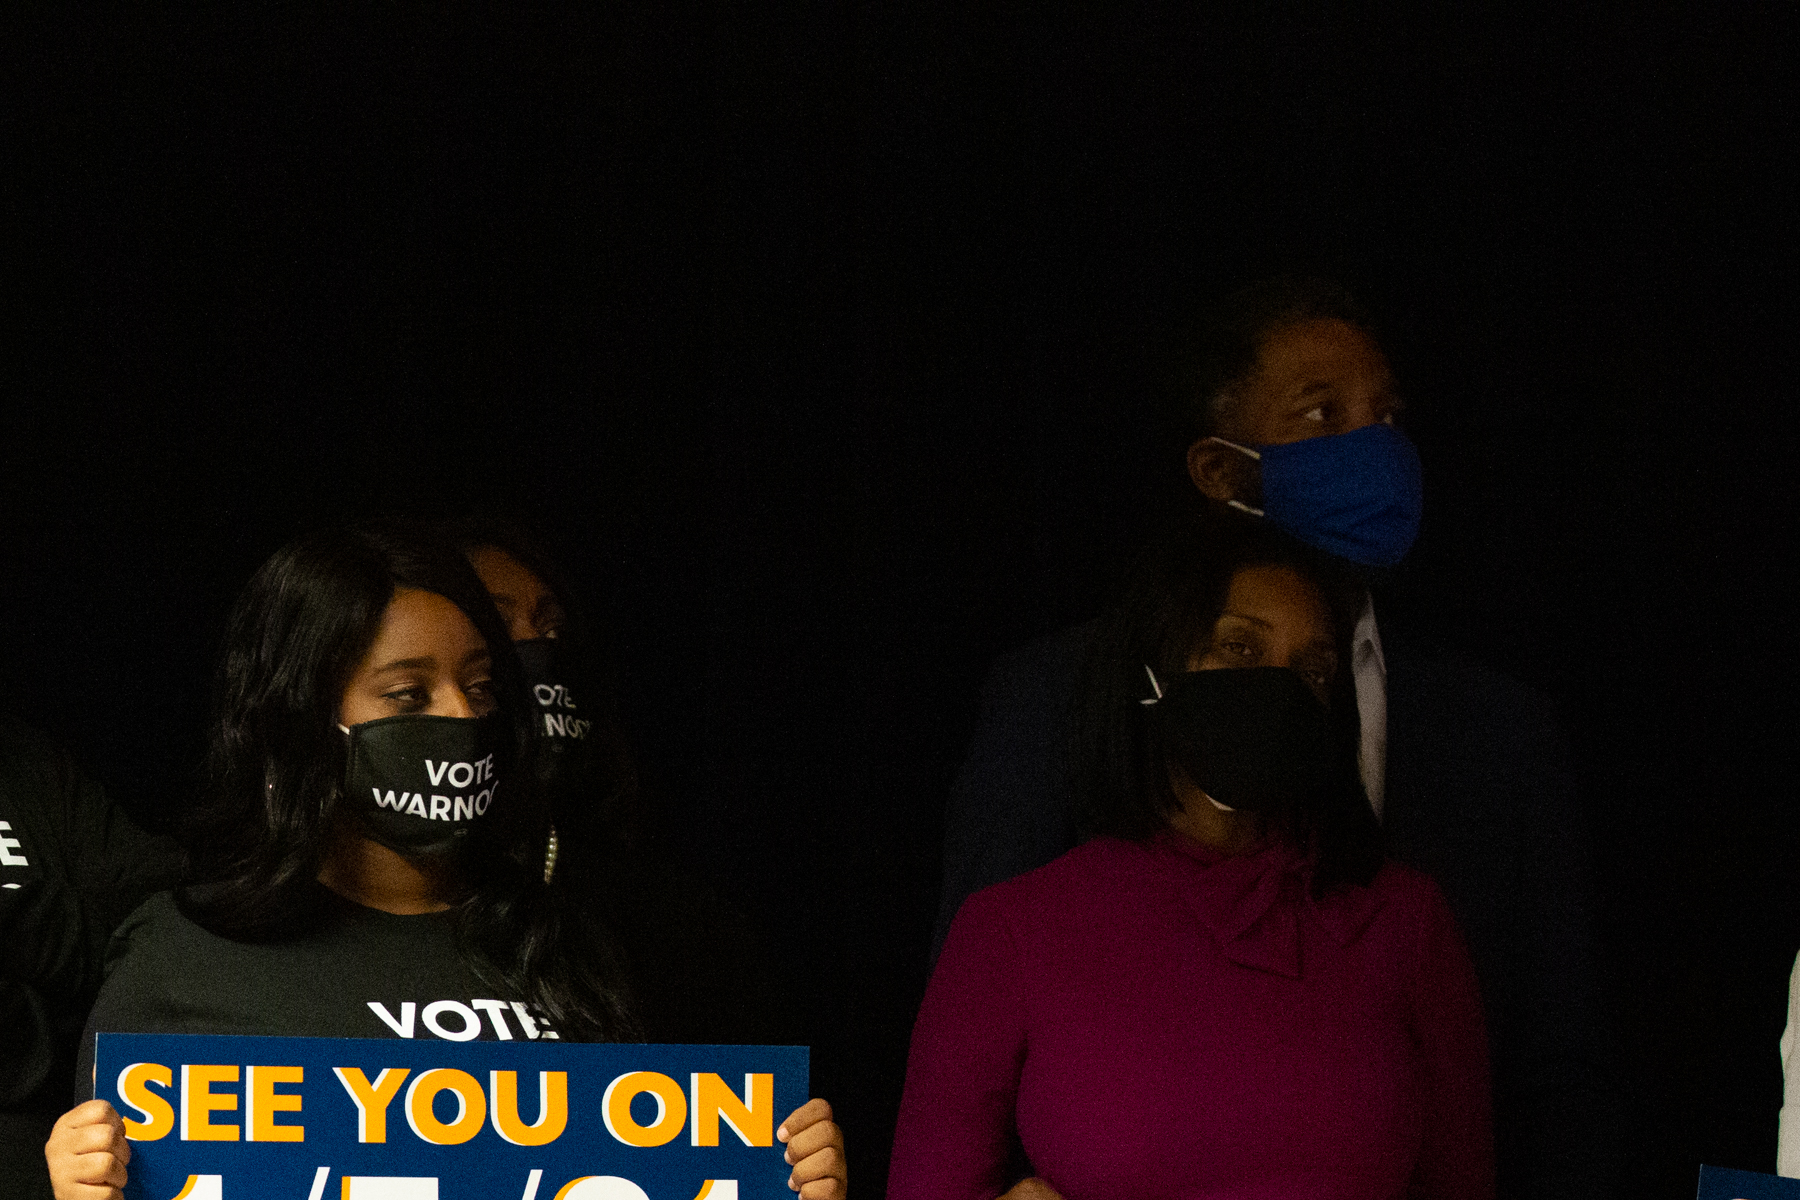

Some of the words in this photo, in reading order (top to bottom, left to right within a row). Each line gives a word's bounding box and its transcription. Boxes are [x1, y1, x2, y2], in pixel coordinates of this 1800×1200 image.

[533, 684, 576, 708] OTE
[425, 753, 493, 788] VOTE
[372, 780, 499, 822] WARNO
[117, 1062, 305, 1142] SEE
[333, 1066, 569, 1147] YOU
[601, 1070, 774, 1148] ON
